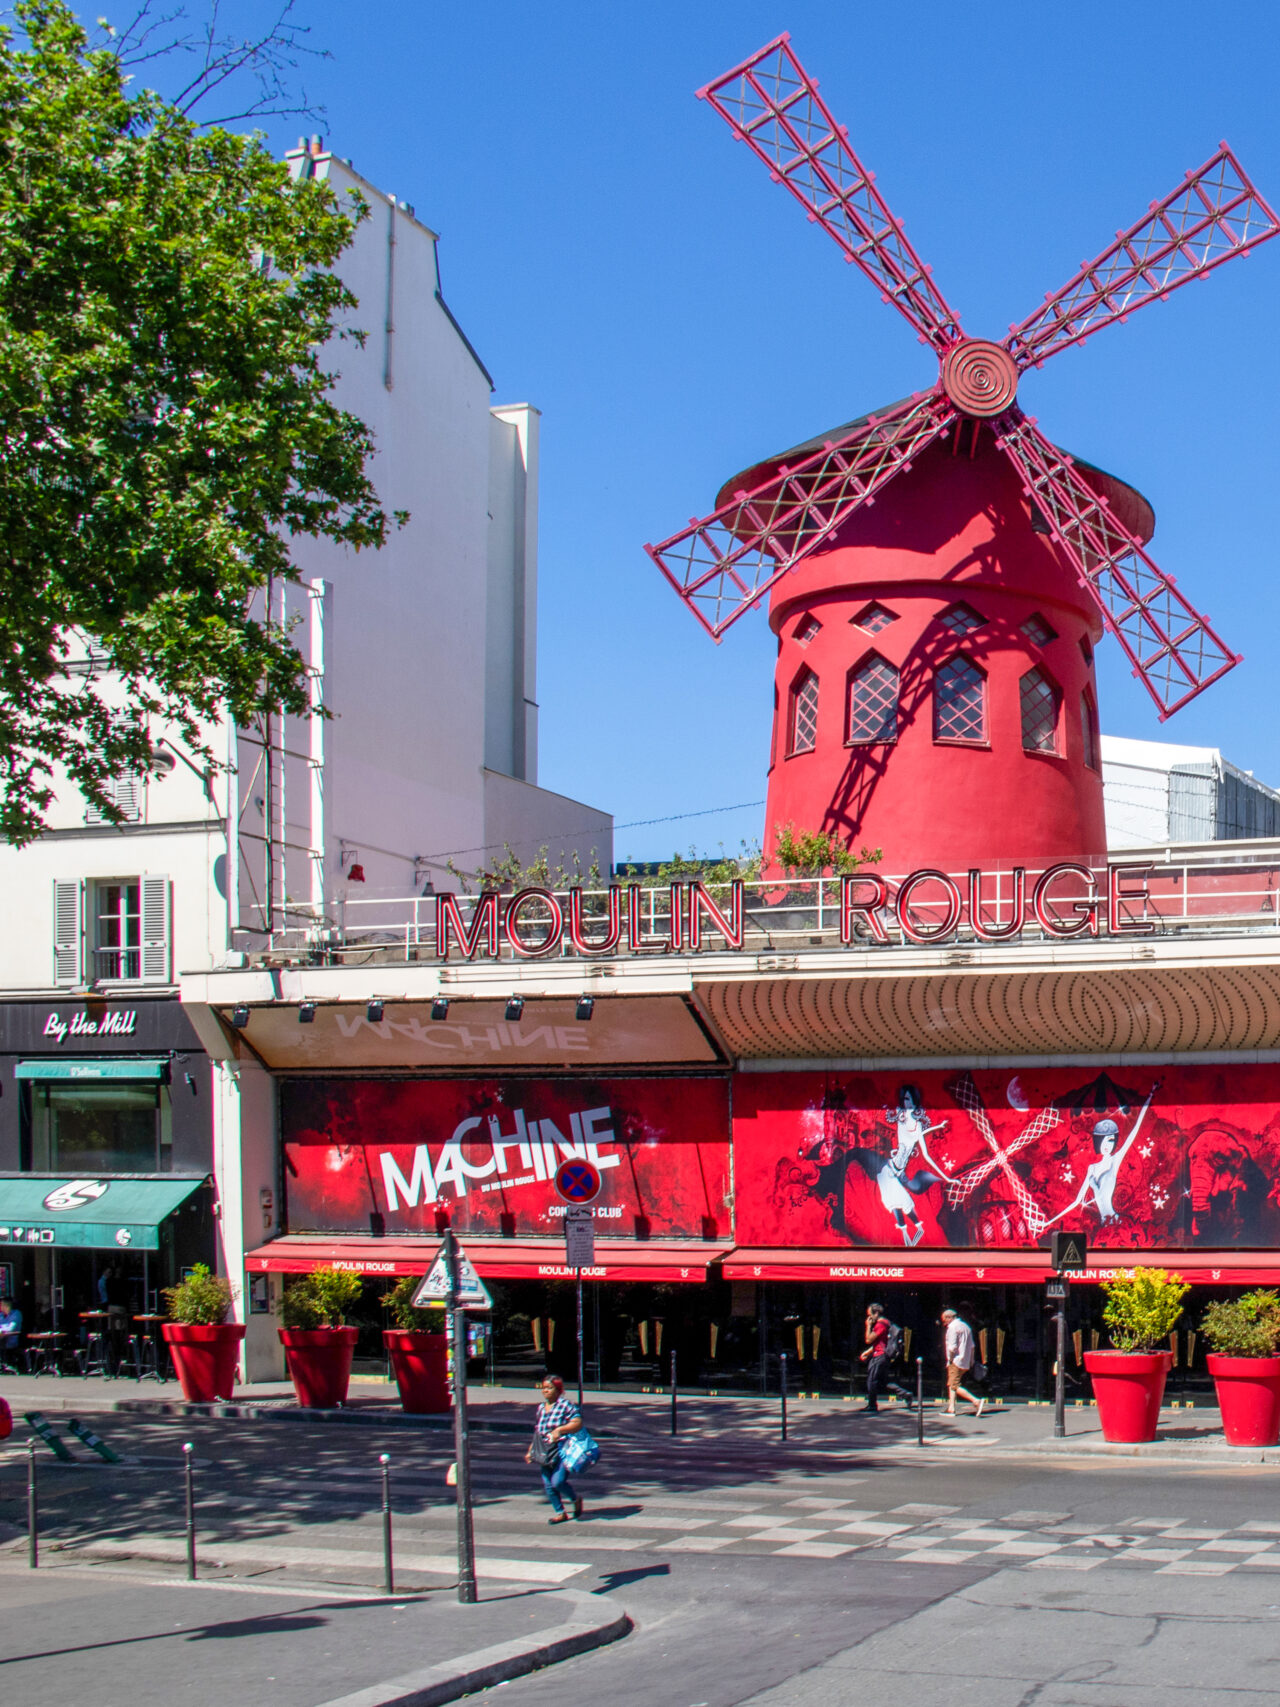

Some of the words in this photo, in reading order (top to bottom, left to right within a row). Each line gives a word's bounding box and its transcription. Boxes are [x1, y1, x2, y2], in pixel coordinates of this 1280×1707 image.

[436, 879, 745, 958] MOULIN
[840, 862, 1155, 944] ROUGE
[44, 1012, 67, 1042] By
[70, 1011, 97, 1034] the
[98, 1010, 136, 1034] Mill
[380, 1106, 620, 1211] MACHINE
[481, 1184, 491, 1192] DU
[491, 1179, 514, 1190] MOULIN
[514, 1175, 535, 1186] ROUGE
[597, 1207, 622, 1218] CLUB
[333, 1261, 365, 1271] MOULIN
[366, 1262, 395, 1272] ROUGE
[539, 1266, 574, 1276] MOULIN
[575, 1267, 606, 1276] OUGE
[830, 1267, 868, 1276] MOULIN
[870, 1267, 904, 1277] ROUGE
[1057, 1269, 1097, 1279] OULIN
